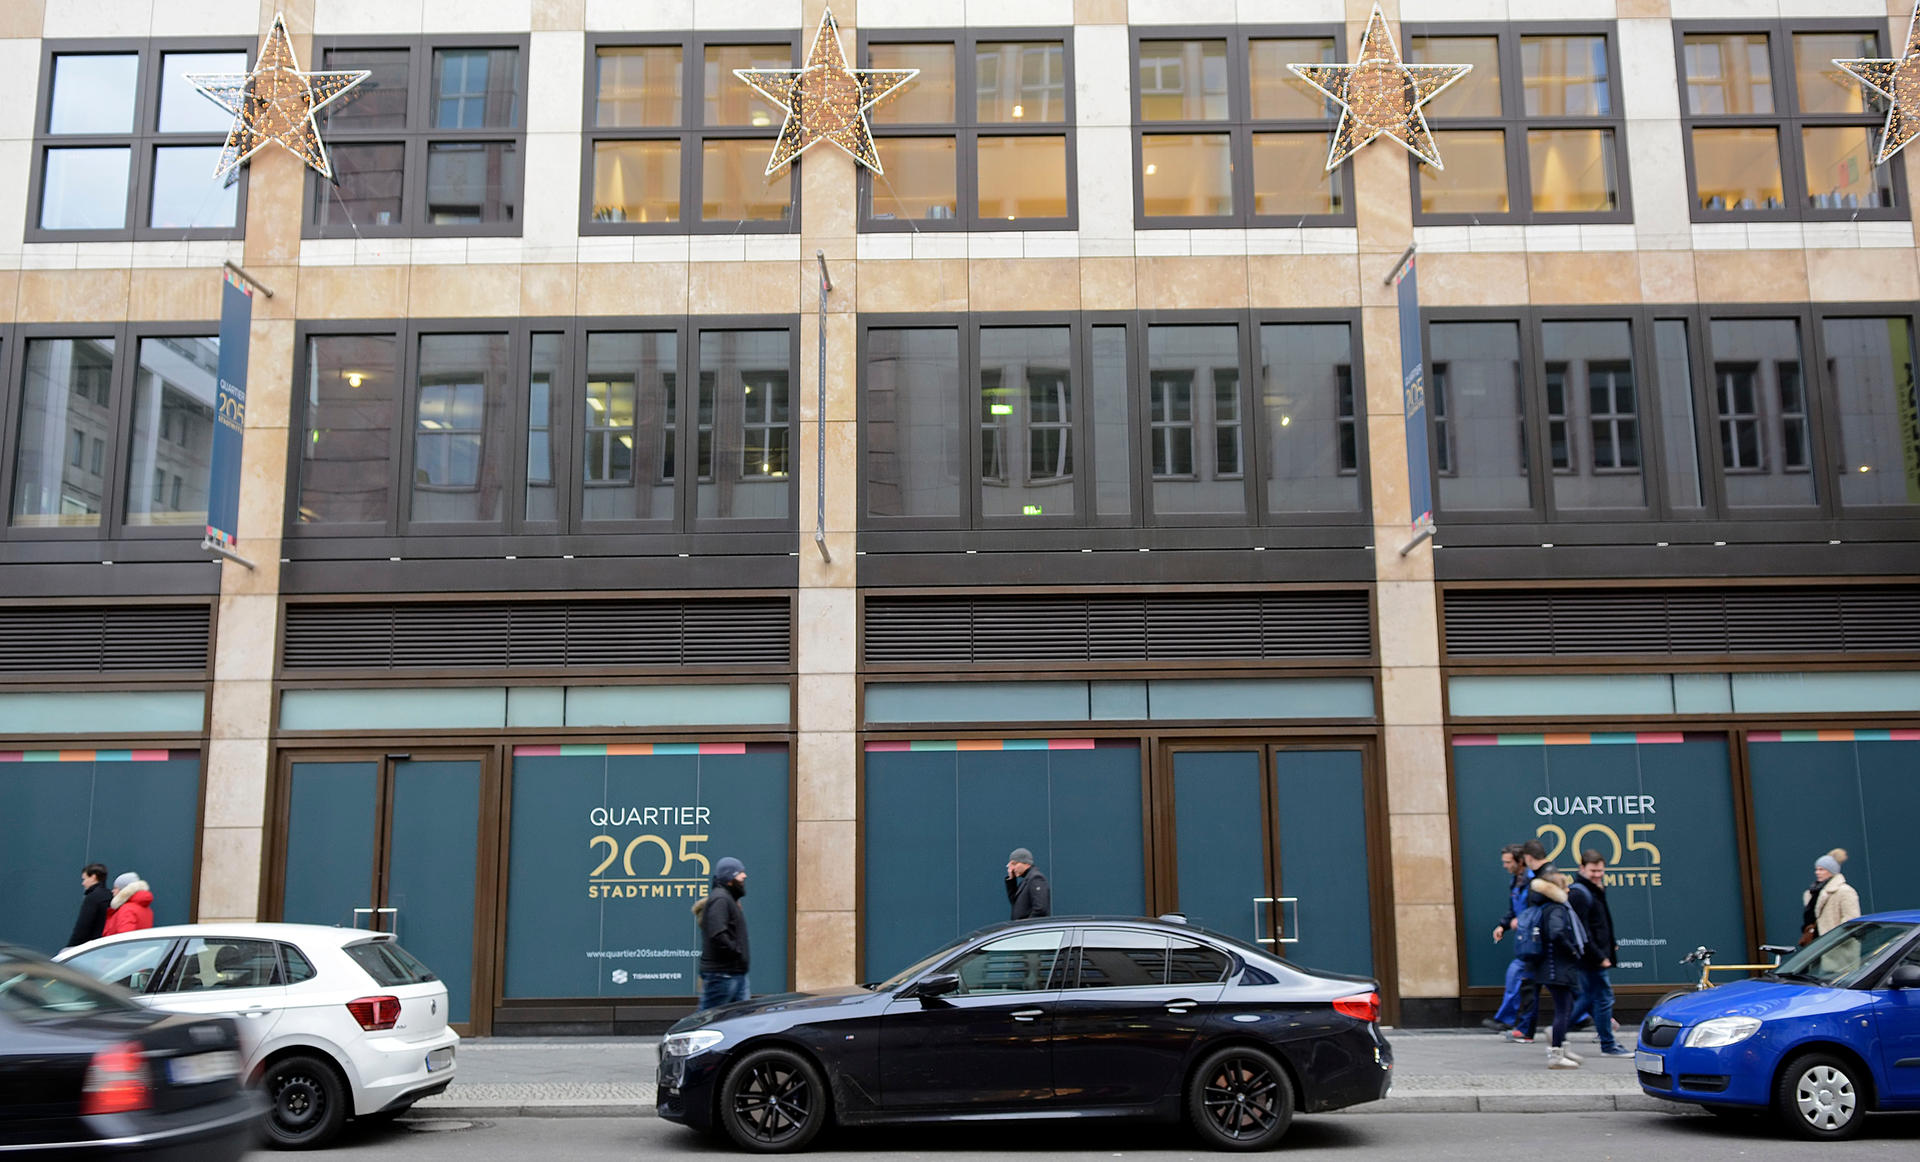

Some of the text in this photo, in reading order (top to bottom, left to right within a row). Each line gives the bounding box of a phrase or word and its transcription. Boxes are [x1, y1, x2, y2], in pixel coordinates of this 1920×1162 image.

[219, 392, 245, 424] 205
[1533, 795, 1656, 816] QUARTIER
[589, 807, 711, 826] QUARTIER
[1535, 823, 1661, 865] 205
[588, 834, 711, 876] 205
[1565, 873, 1662, 887] AMITTE
[588, 884, 710, 898] STADTMITTE
